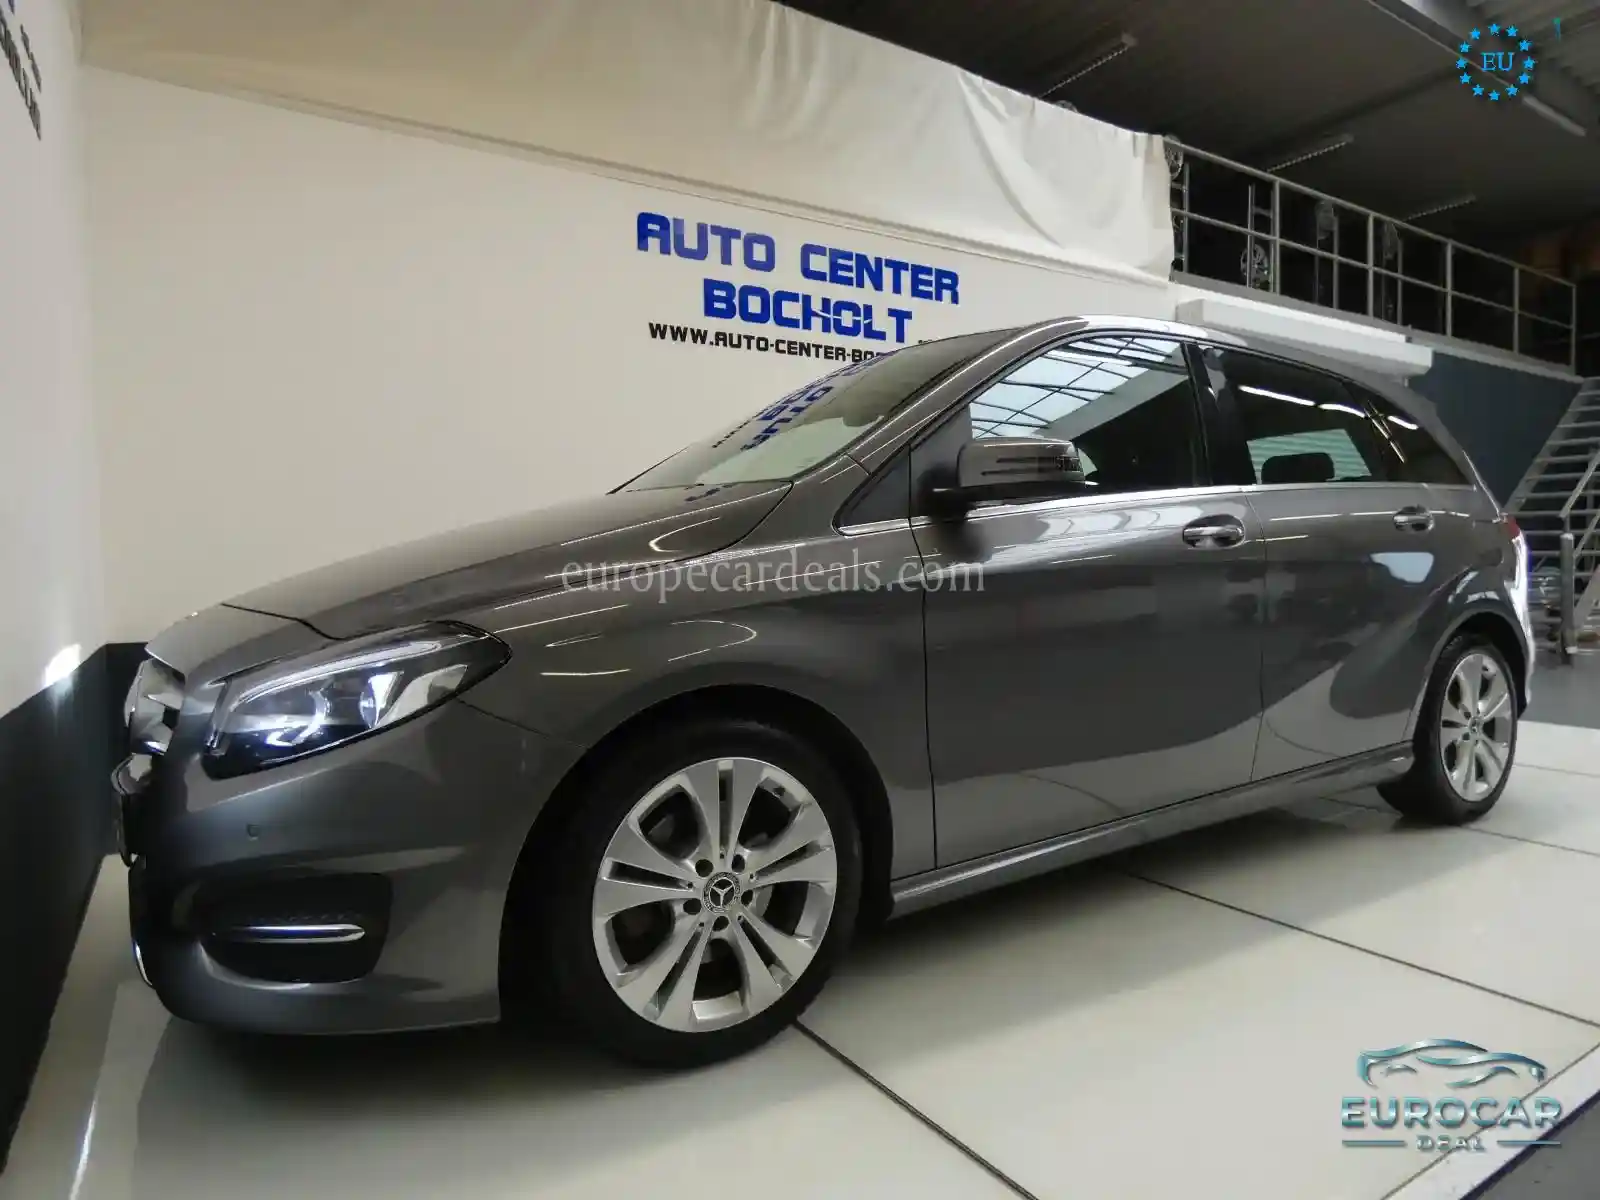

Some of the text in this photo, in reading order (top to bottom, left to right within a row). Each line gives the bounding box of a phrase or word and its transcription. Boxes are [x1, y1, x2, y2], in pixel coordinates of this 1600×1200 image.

[636, 211, 960, 305] AUTO CENTER
[648, 322, 878, 363] WWW.AUTO-CENTER-BO
[703, 278, 913, 344] BOCHOLT
